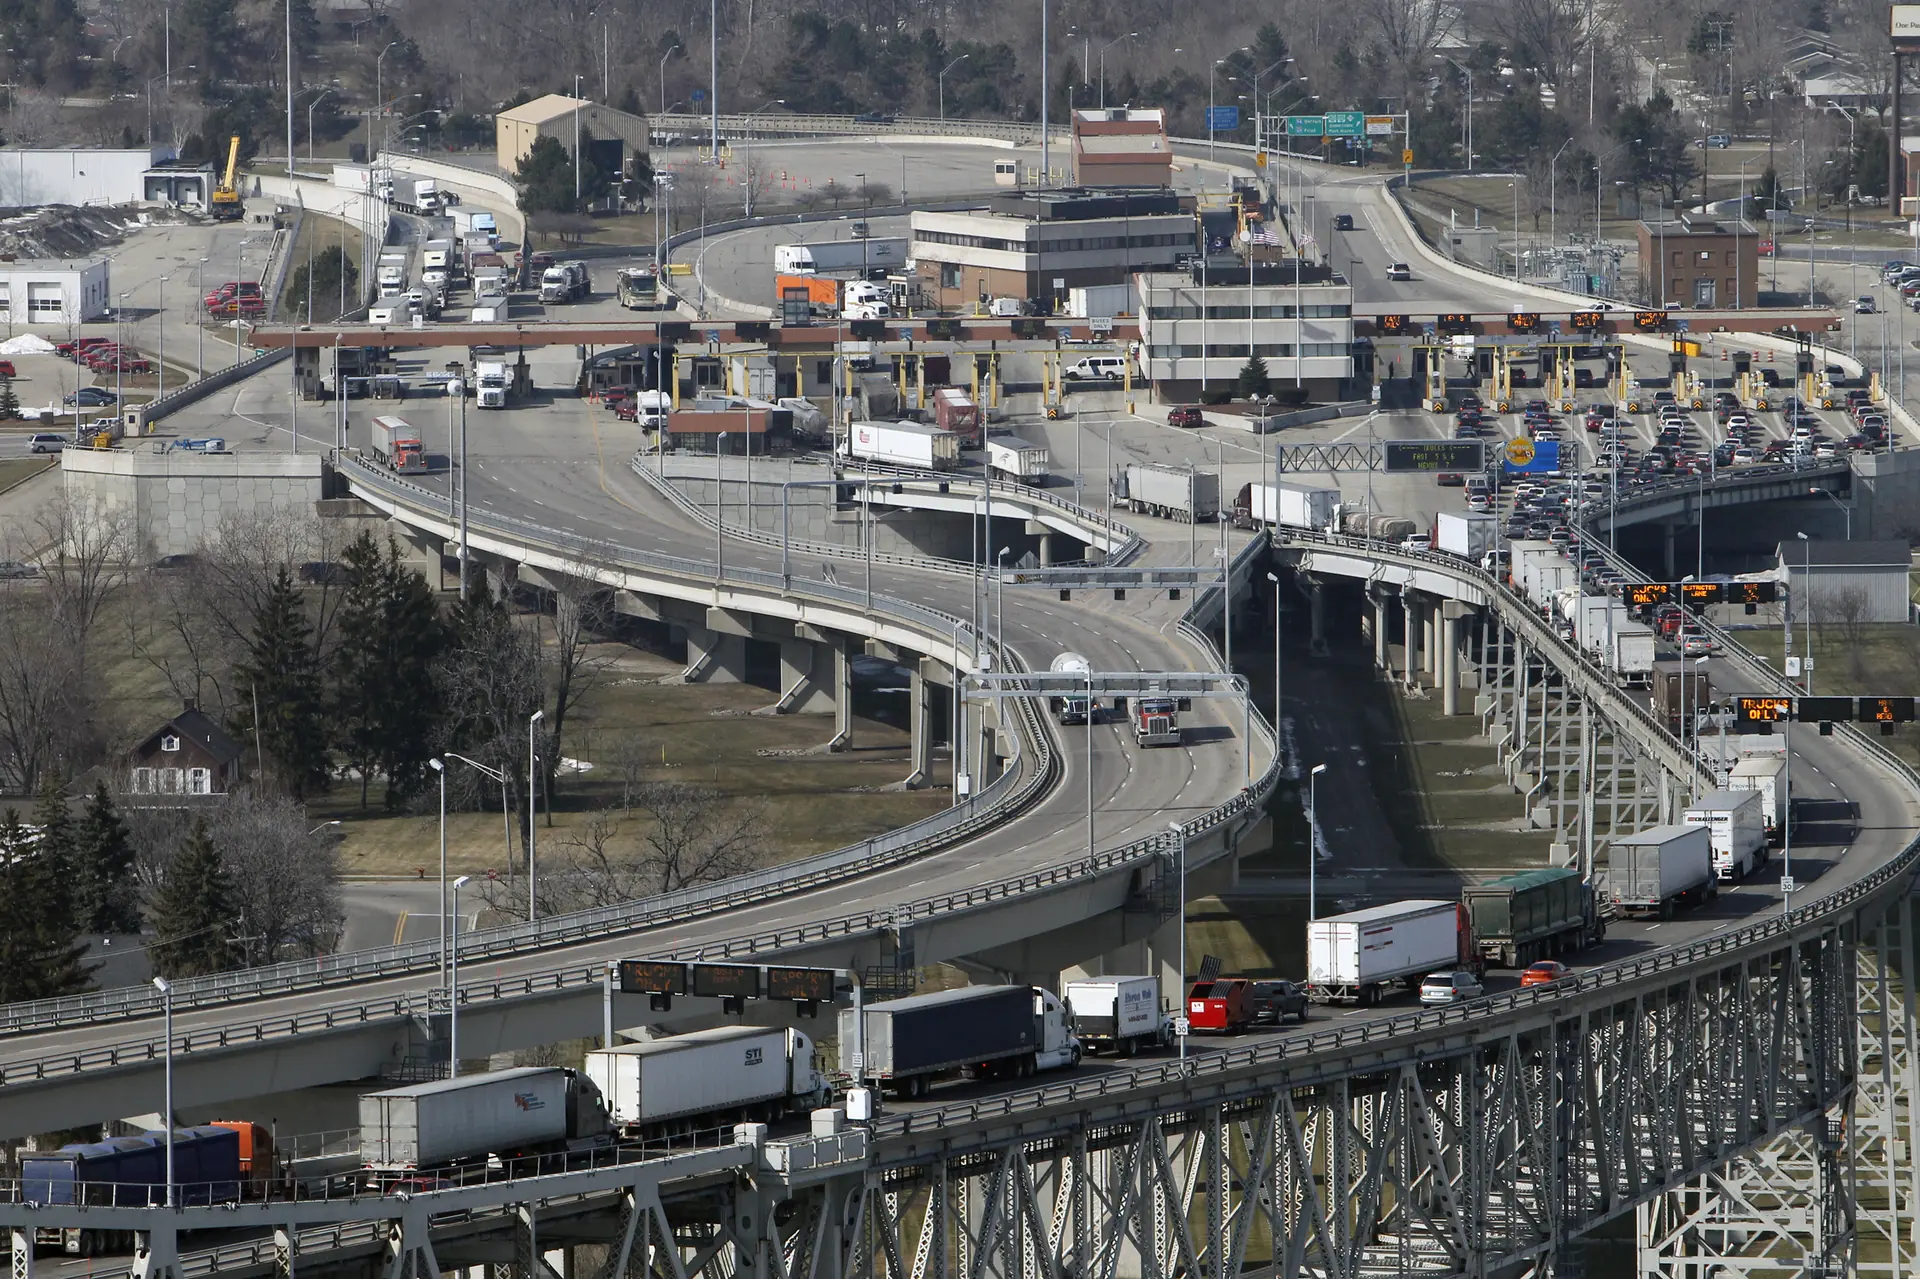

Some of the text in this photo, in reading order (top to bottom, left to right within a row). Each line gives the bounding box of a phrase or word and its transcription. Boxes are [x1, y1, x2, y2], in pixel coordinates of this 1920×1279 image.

[1749, 709, 1778, 719] ONLY
[1176, 1026, 1187, 1034] 30
[745, 1047, 763, 1060] STI
